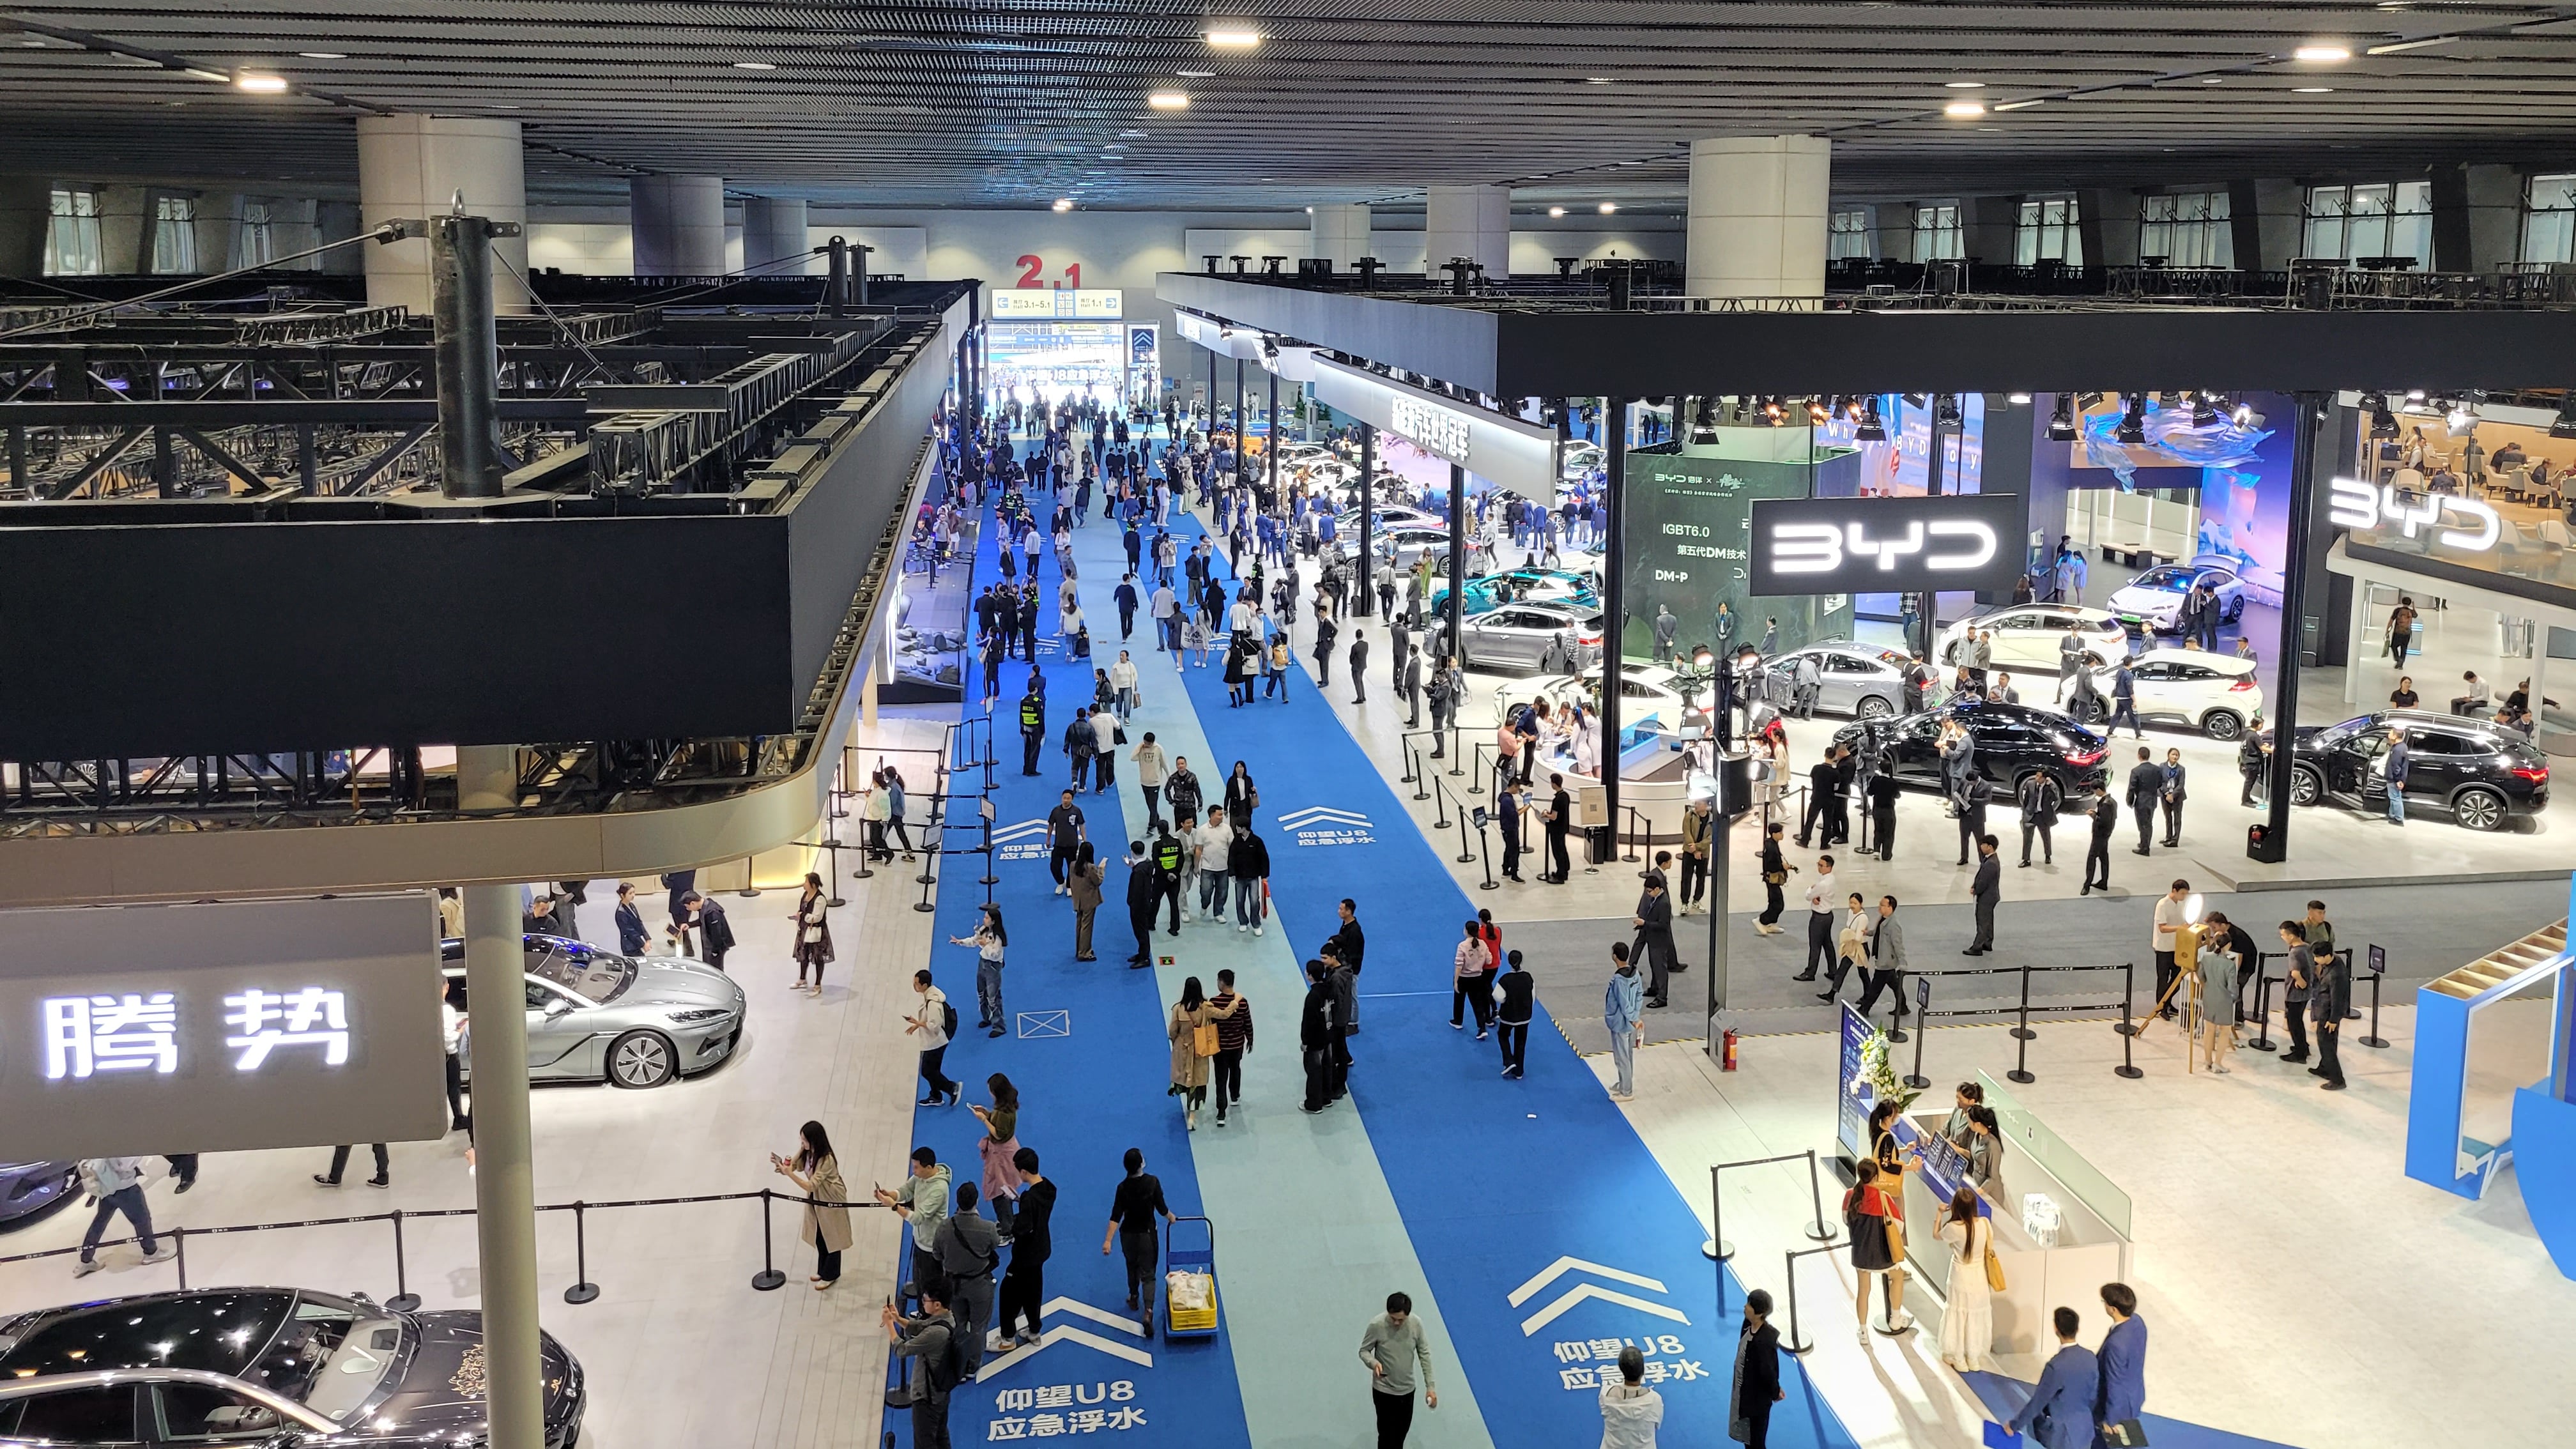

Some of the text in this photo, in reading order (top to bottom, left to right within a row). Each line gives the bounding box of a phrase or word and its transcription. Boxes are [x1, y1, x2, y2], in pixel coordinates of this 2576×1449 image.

[1016, 255, 1080, 289] 2.1
[1896, 435, 1927, 456] BYD
[1655, 473, 1686, 483] BYD
[2331, 476, 2502, 551] BYD
[1662, 523, 1710, 537] IGBT6.0
[1677, 544, 1746, 560] 第五代DM技术
[1772, 520, 1997, 572] BYD
[1002, 843, 1054, 852] 仰望U
[1298, 830, 1367, 838] 仰望U8
[43, 987, 349, 1078] 腾势
[1554, 1335, 1685, 1363] 仰望U8
[995, 1380, 1135, 1413] 仰望U8
[987, 1406, 1147, 1442] 应急浮水
